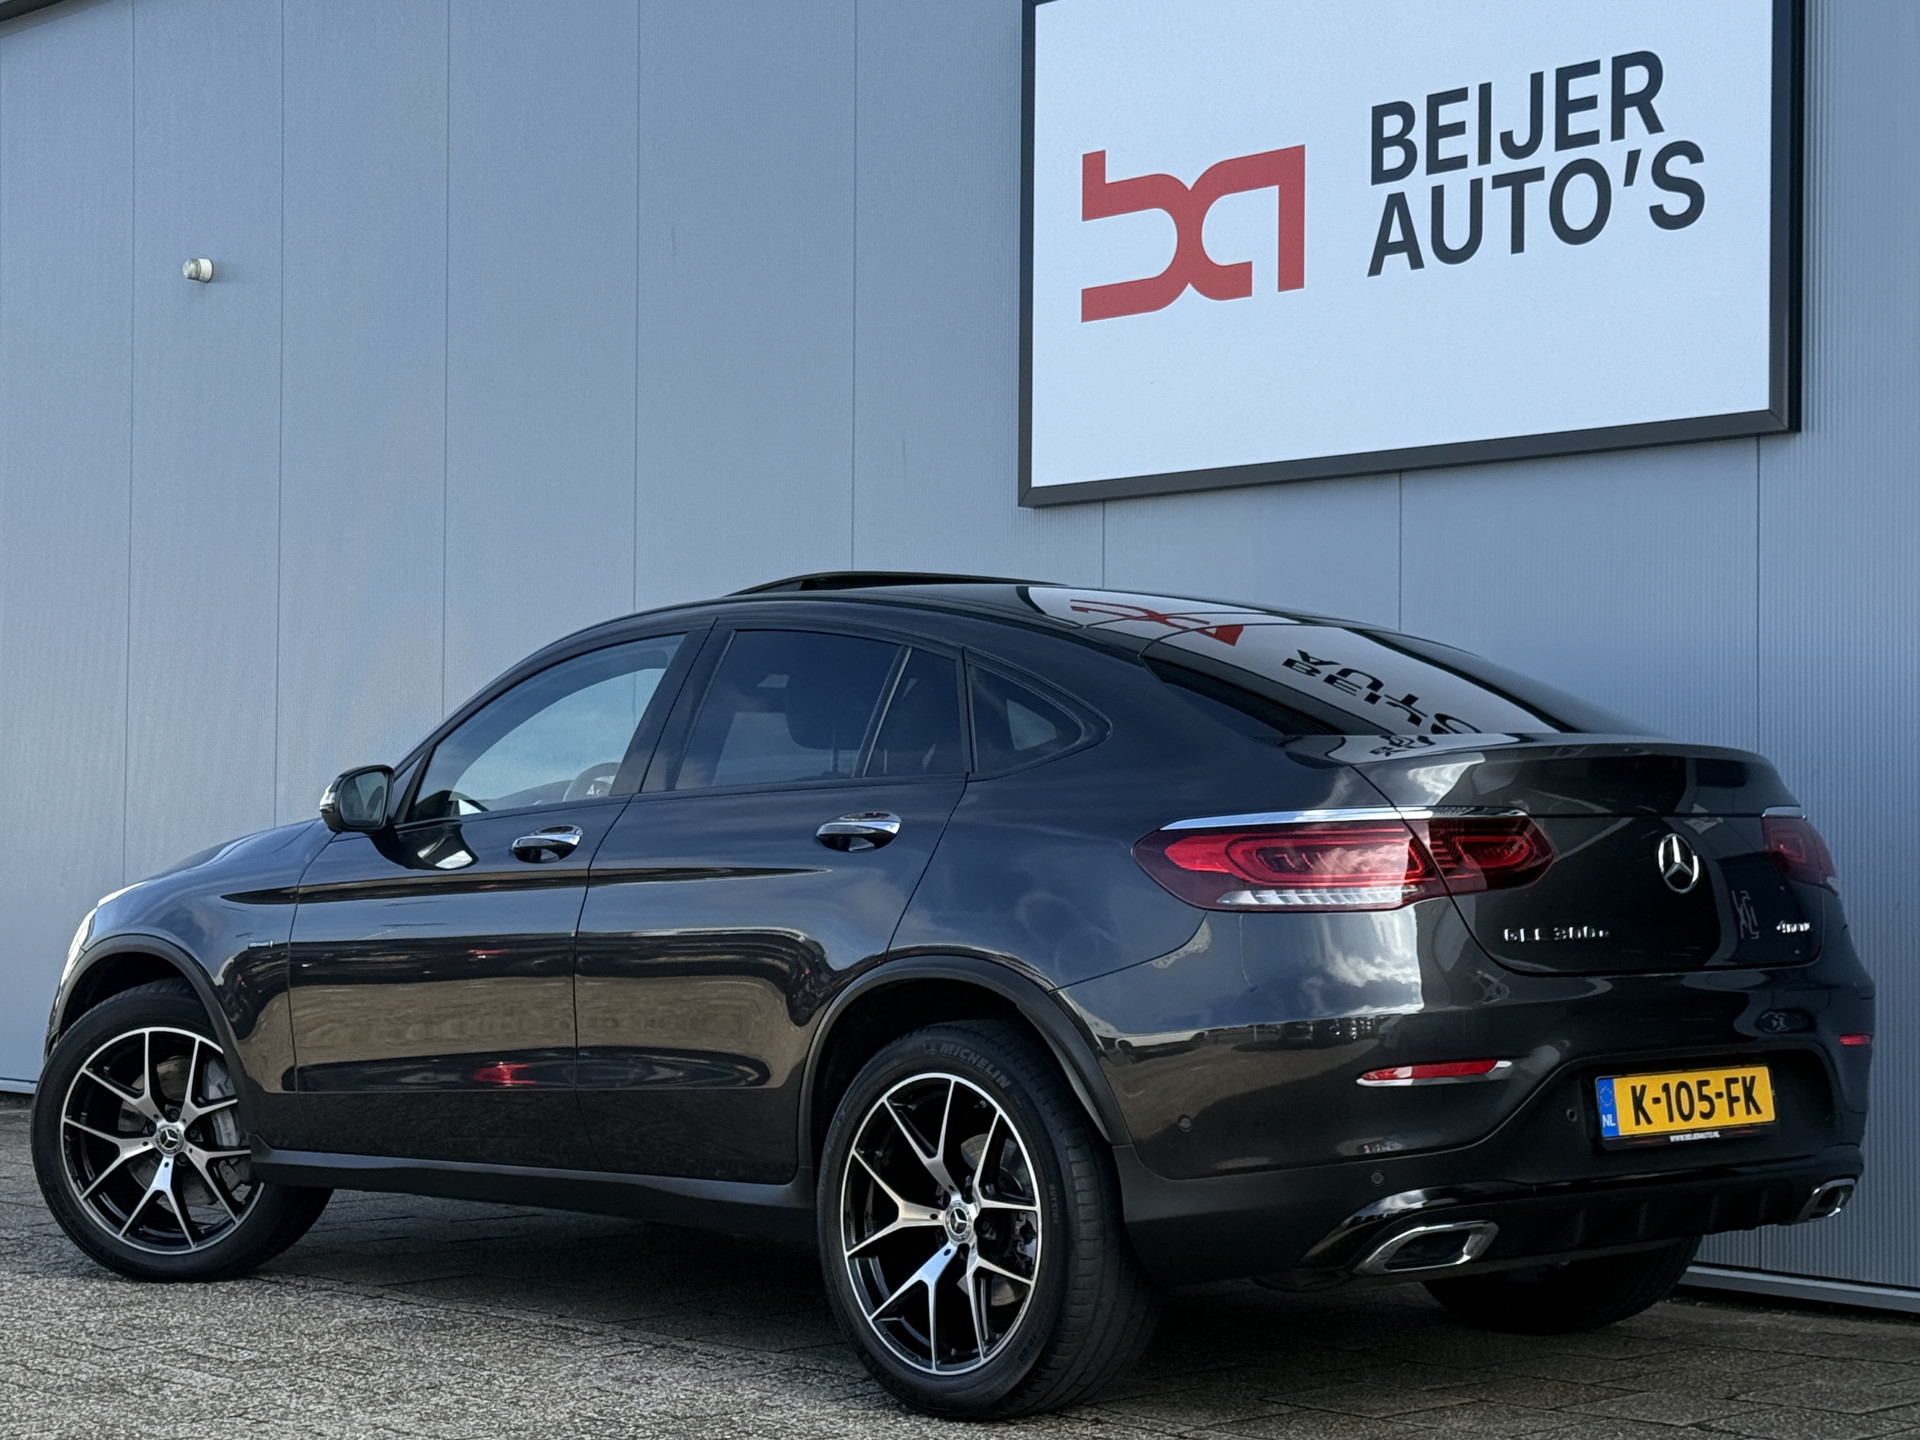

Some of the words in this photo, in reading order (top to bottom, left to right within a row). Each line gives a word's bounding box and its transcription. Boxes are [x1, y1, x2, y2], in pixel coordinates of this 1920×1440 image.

[1370, 50, 1665, 186] BEIJER
[1367, 140, 1706, 277] AUTO'S
[938, 1042, 1012, 1089] MICHELIN
[1602, 1113, 1617, 1128] NL
[1630, 1075, 1763, 1127] K-105-FK
